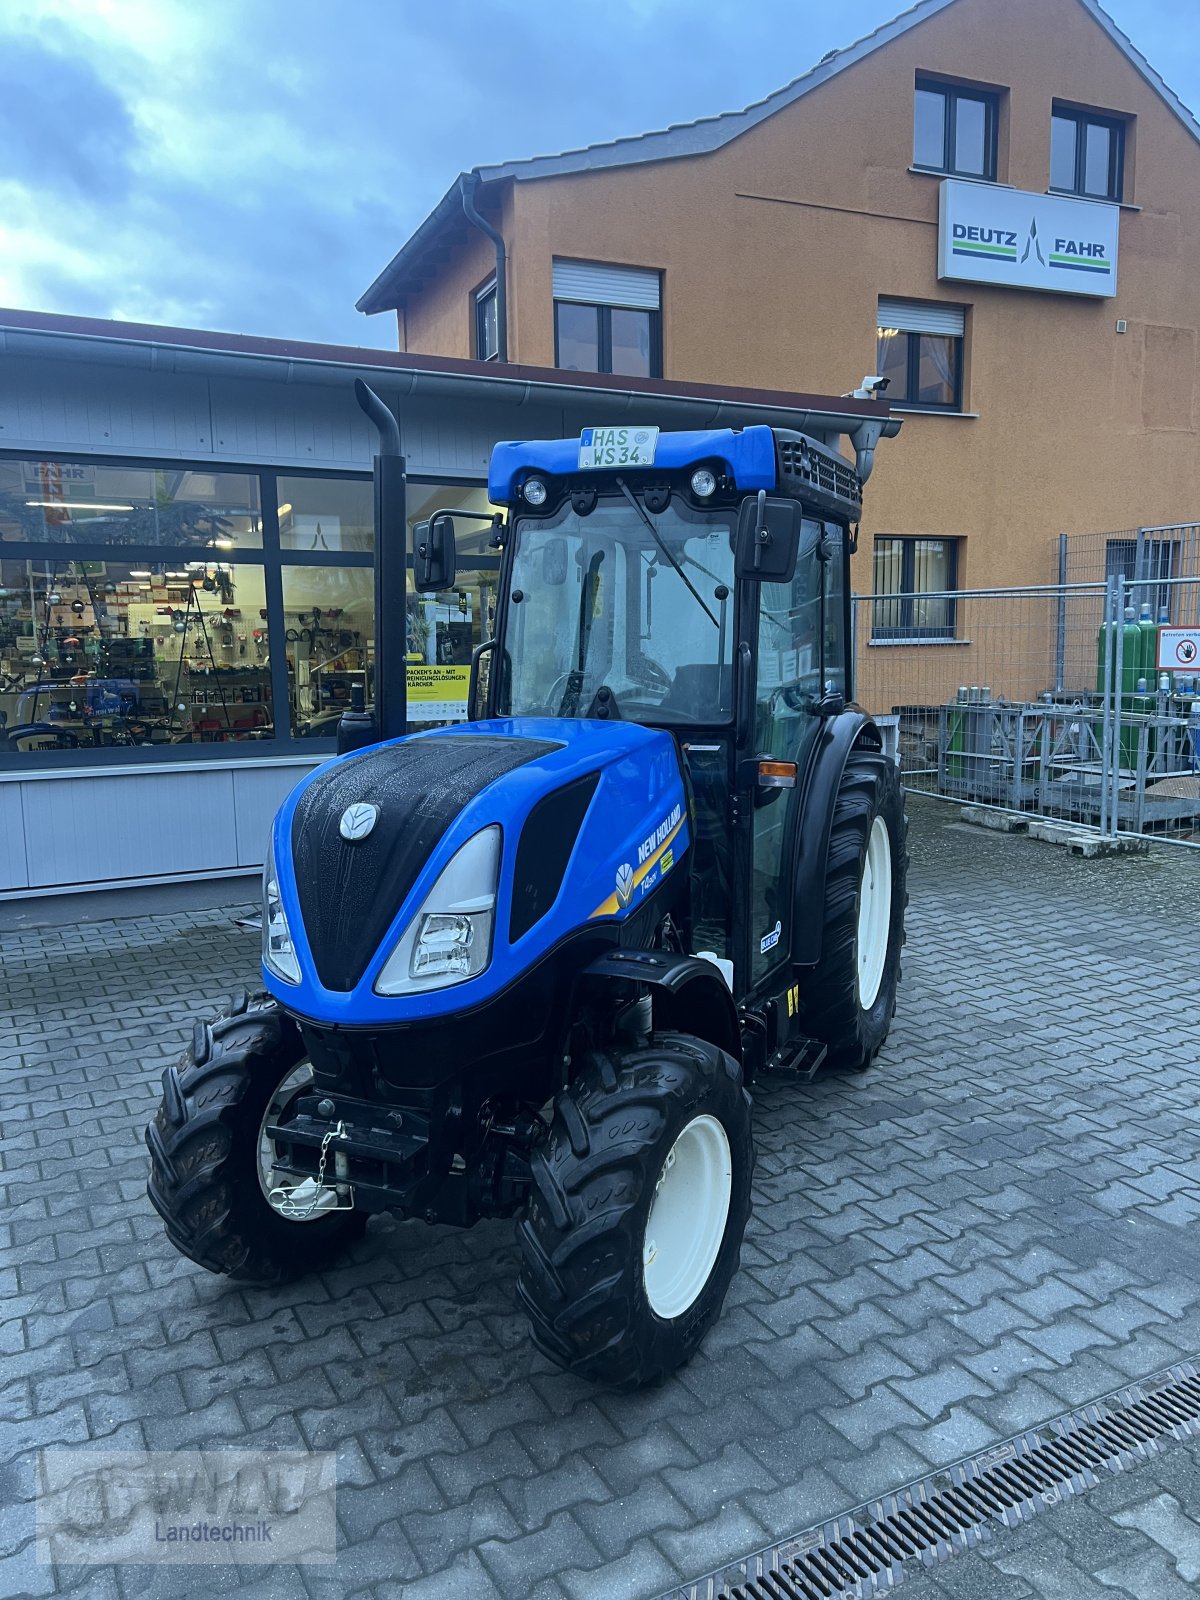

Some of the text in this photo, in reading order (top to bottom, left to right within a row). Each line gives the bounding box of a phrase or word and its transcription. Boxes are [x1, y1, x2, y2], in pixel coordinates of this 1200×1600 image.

[952, 223, 1105, 258] DEUTZ FAHR
[593, 430, 629, 447] HAS
[638, 831, 656, 864] NEW
[656, 803, 681, 846] HOLLAND
